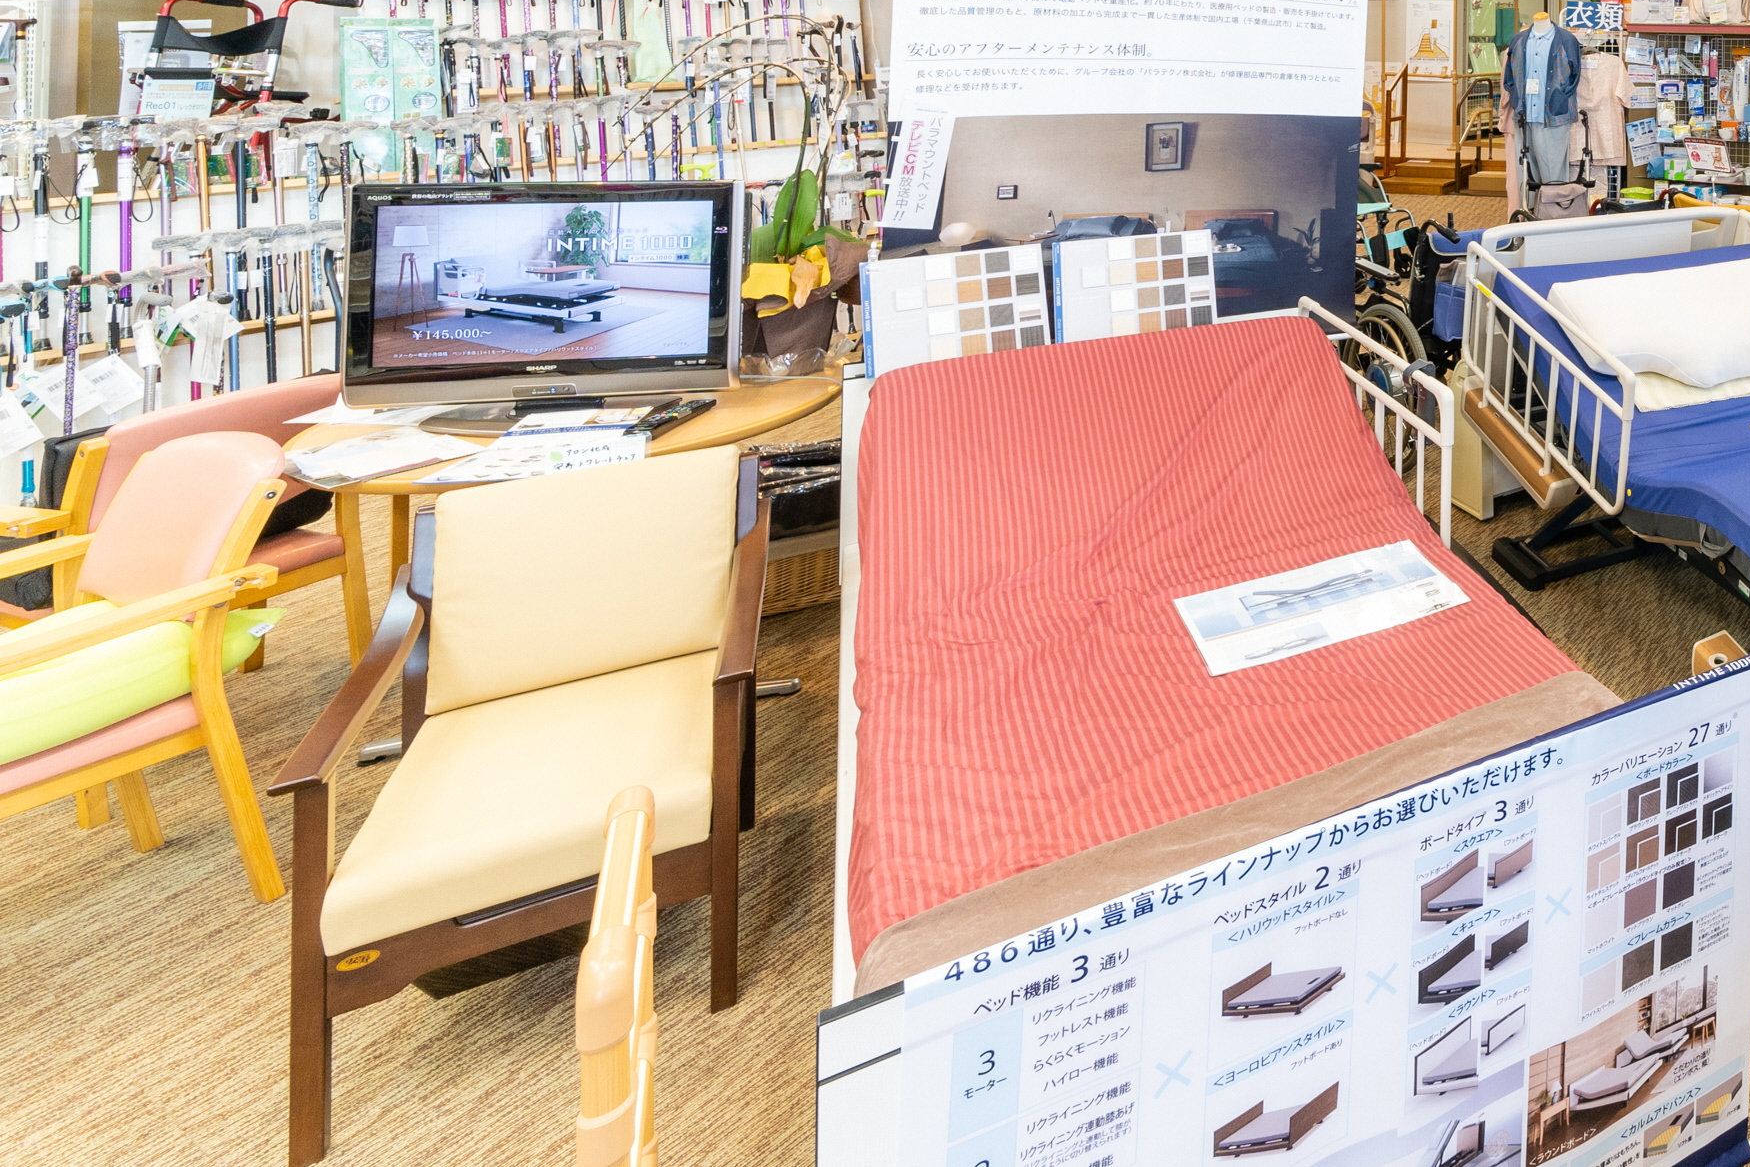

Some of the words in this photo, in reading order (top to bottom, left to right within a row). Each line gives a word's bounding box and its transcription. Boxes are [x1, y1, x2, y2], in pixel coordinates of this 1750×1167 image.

[1567, 1, 1624, 31] 衣類
[907, 42, 1152, 57] 安心のアフターメンテナンス体制。
[146, 101, 176, 110] Rec01
[915, 117, 943, 213] パラマウントベッド
[547, 237, 634, 252] INTIME
[641, 235, 693, 250] 1000
[566, 445, 610, 456] アロン化成
[1672, 665, 1726, 691] INTIME
[1591, 741, 1683, 786] カラーバリエーション
[1688, 722, 1710, 748] 27
[1715, 720, 1732, 737] 通り
[1420, 811, 1486, 851] ボードタイプ
[1493, 800, 1508, 822] 3
[1514, 795, 1535, 816] 通り
[944, 747, 1563, 982] 486通り、豊富なラインナップからお選びいただけます。
[1213, 881, 1306, 925] ベッドスタイル
[1314, 865, 1330, 891] 2
[1337, 859, 1362, 881] 通り
[1294, 909, 1348, 935] フットボードなし
[974, 975, 1059, 1015] ベッド機能
[1070, 955, 1089, 983] 3
[1099, 948, 1130, 973] 通り
[1032, 977, 1136, 1025] リクライニング機能
[1038, 1003, 1128, 1046] フットレスト機能
[978, 1050, 995, 1076] 3
[1033, 1026, 1131, 1072] らくらくモーション
[1290, 1039, 1343, 1070] フットボードあり
[964, 1077, 1007, 1099] モーター
[1043, 1053, 1119, 1092] ハイロー機能
[1026, 1081, 1132, 1134] リクライニング機能
